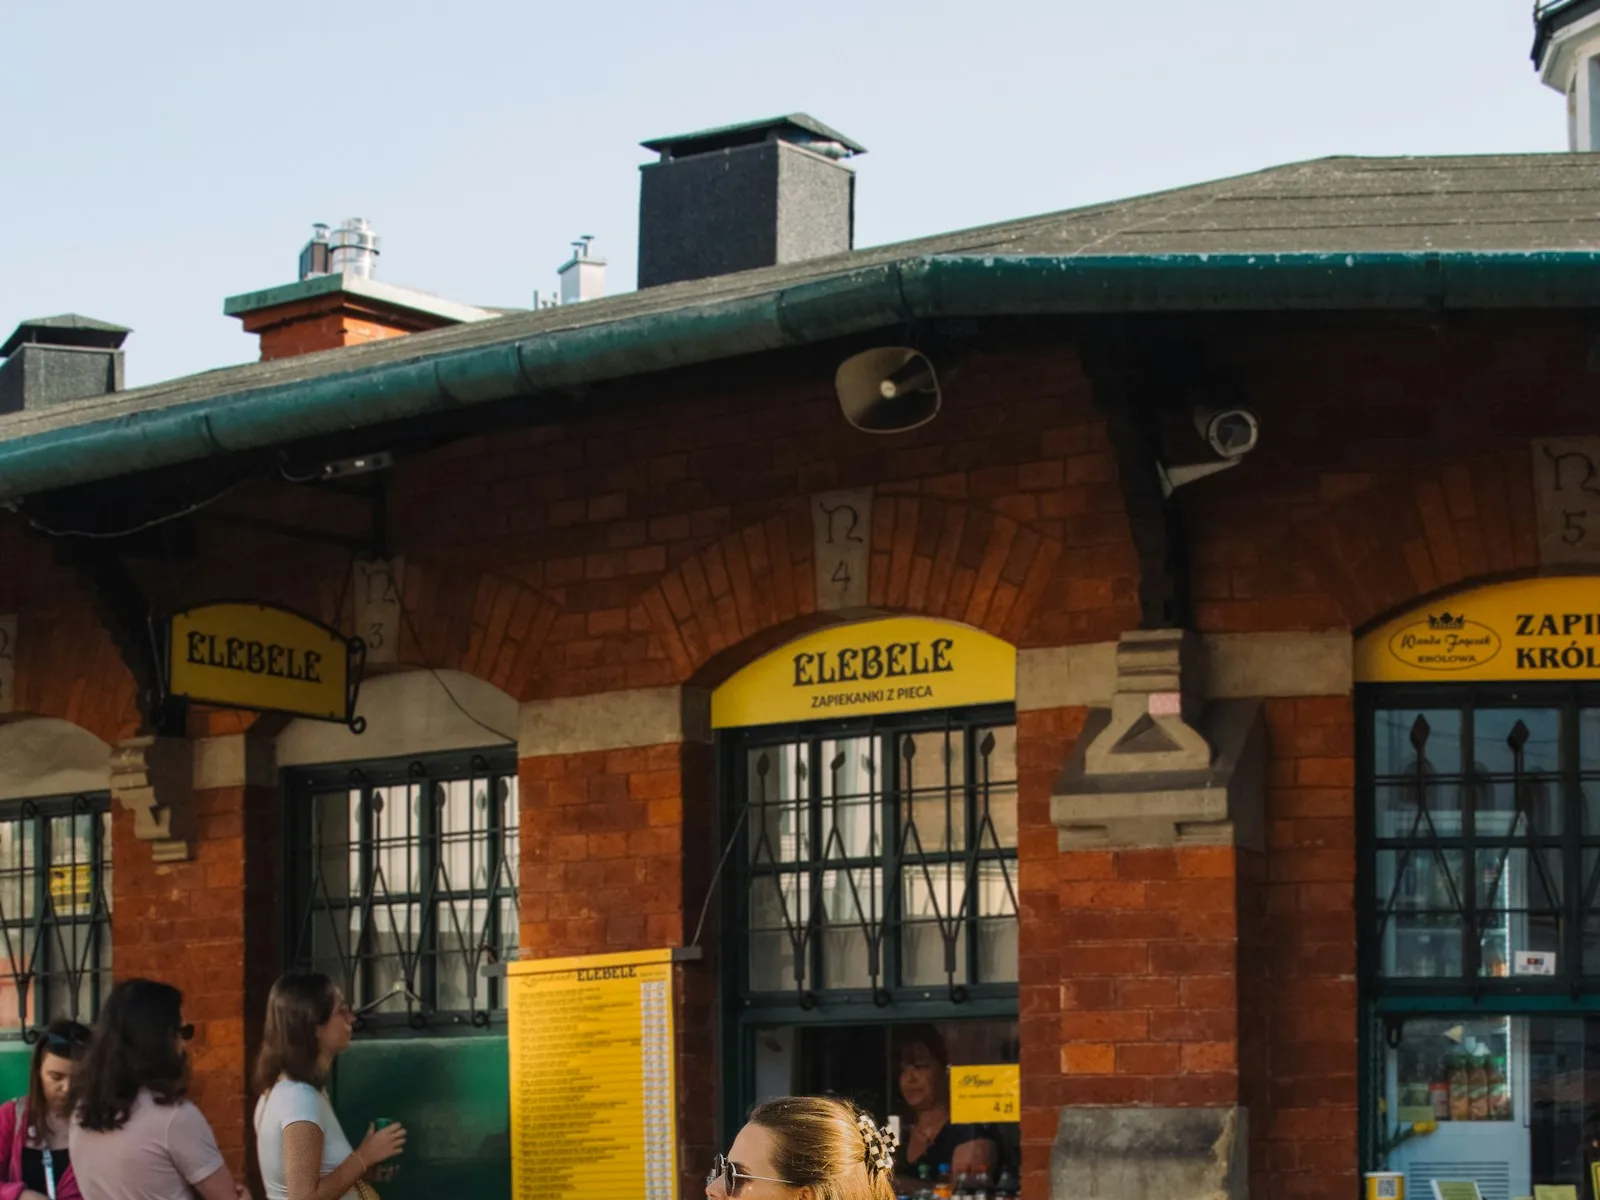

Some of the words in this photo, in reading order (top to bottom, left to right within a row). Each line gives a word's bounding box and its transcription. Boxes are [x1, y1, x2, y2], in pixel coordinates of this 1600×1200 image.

[1561, 509, 1587, 545] 5
[830, 560, 852, 593] 4
[368, 622, 384, 650] 3
[1515, 613, 1600, 636] ZAPI
[185, 630, 322, 684] ELEBELE
[792, 638, 954, 688] ELEBELE
[811, 690, 884, 709] ZAPIEKANKI
[886, 689, 895, 702] Z
[896, 685, 933, 700] PIECA
[576, 965, 637, 982] ELEBELE
